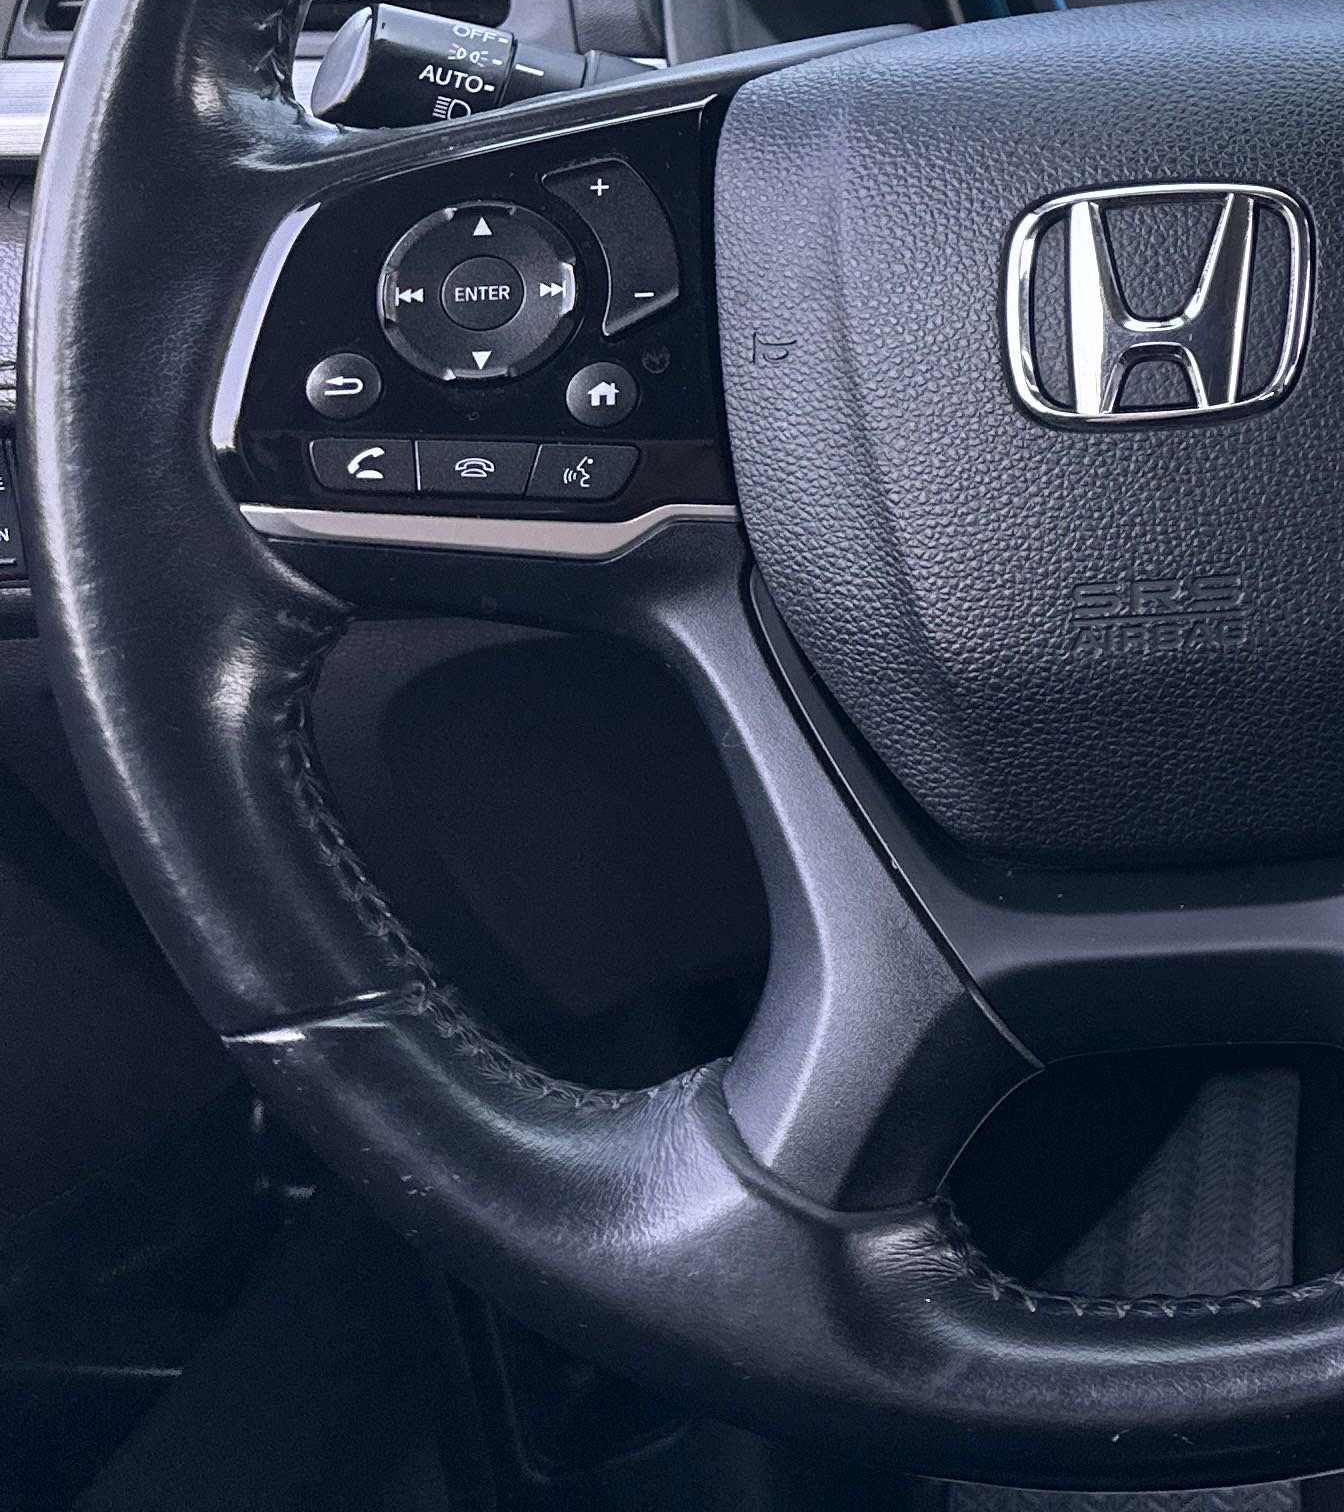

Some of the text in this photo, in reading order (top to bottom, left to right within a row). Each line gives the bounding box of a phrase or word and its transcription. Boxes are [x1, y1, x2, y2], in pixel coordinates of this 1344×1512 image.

[453, 24, 499, 43] OFF
[419, 64, 485, 93] AUTO
[454, 284, 511, 302] ENTER
[1073, 574, 1243, 616] SRS
